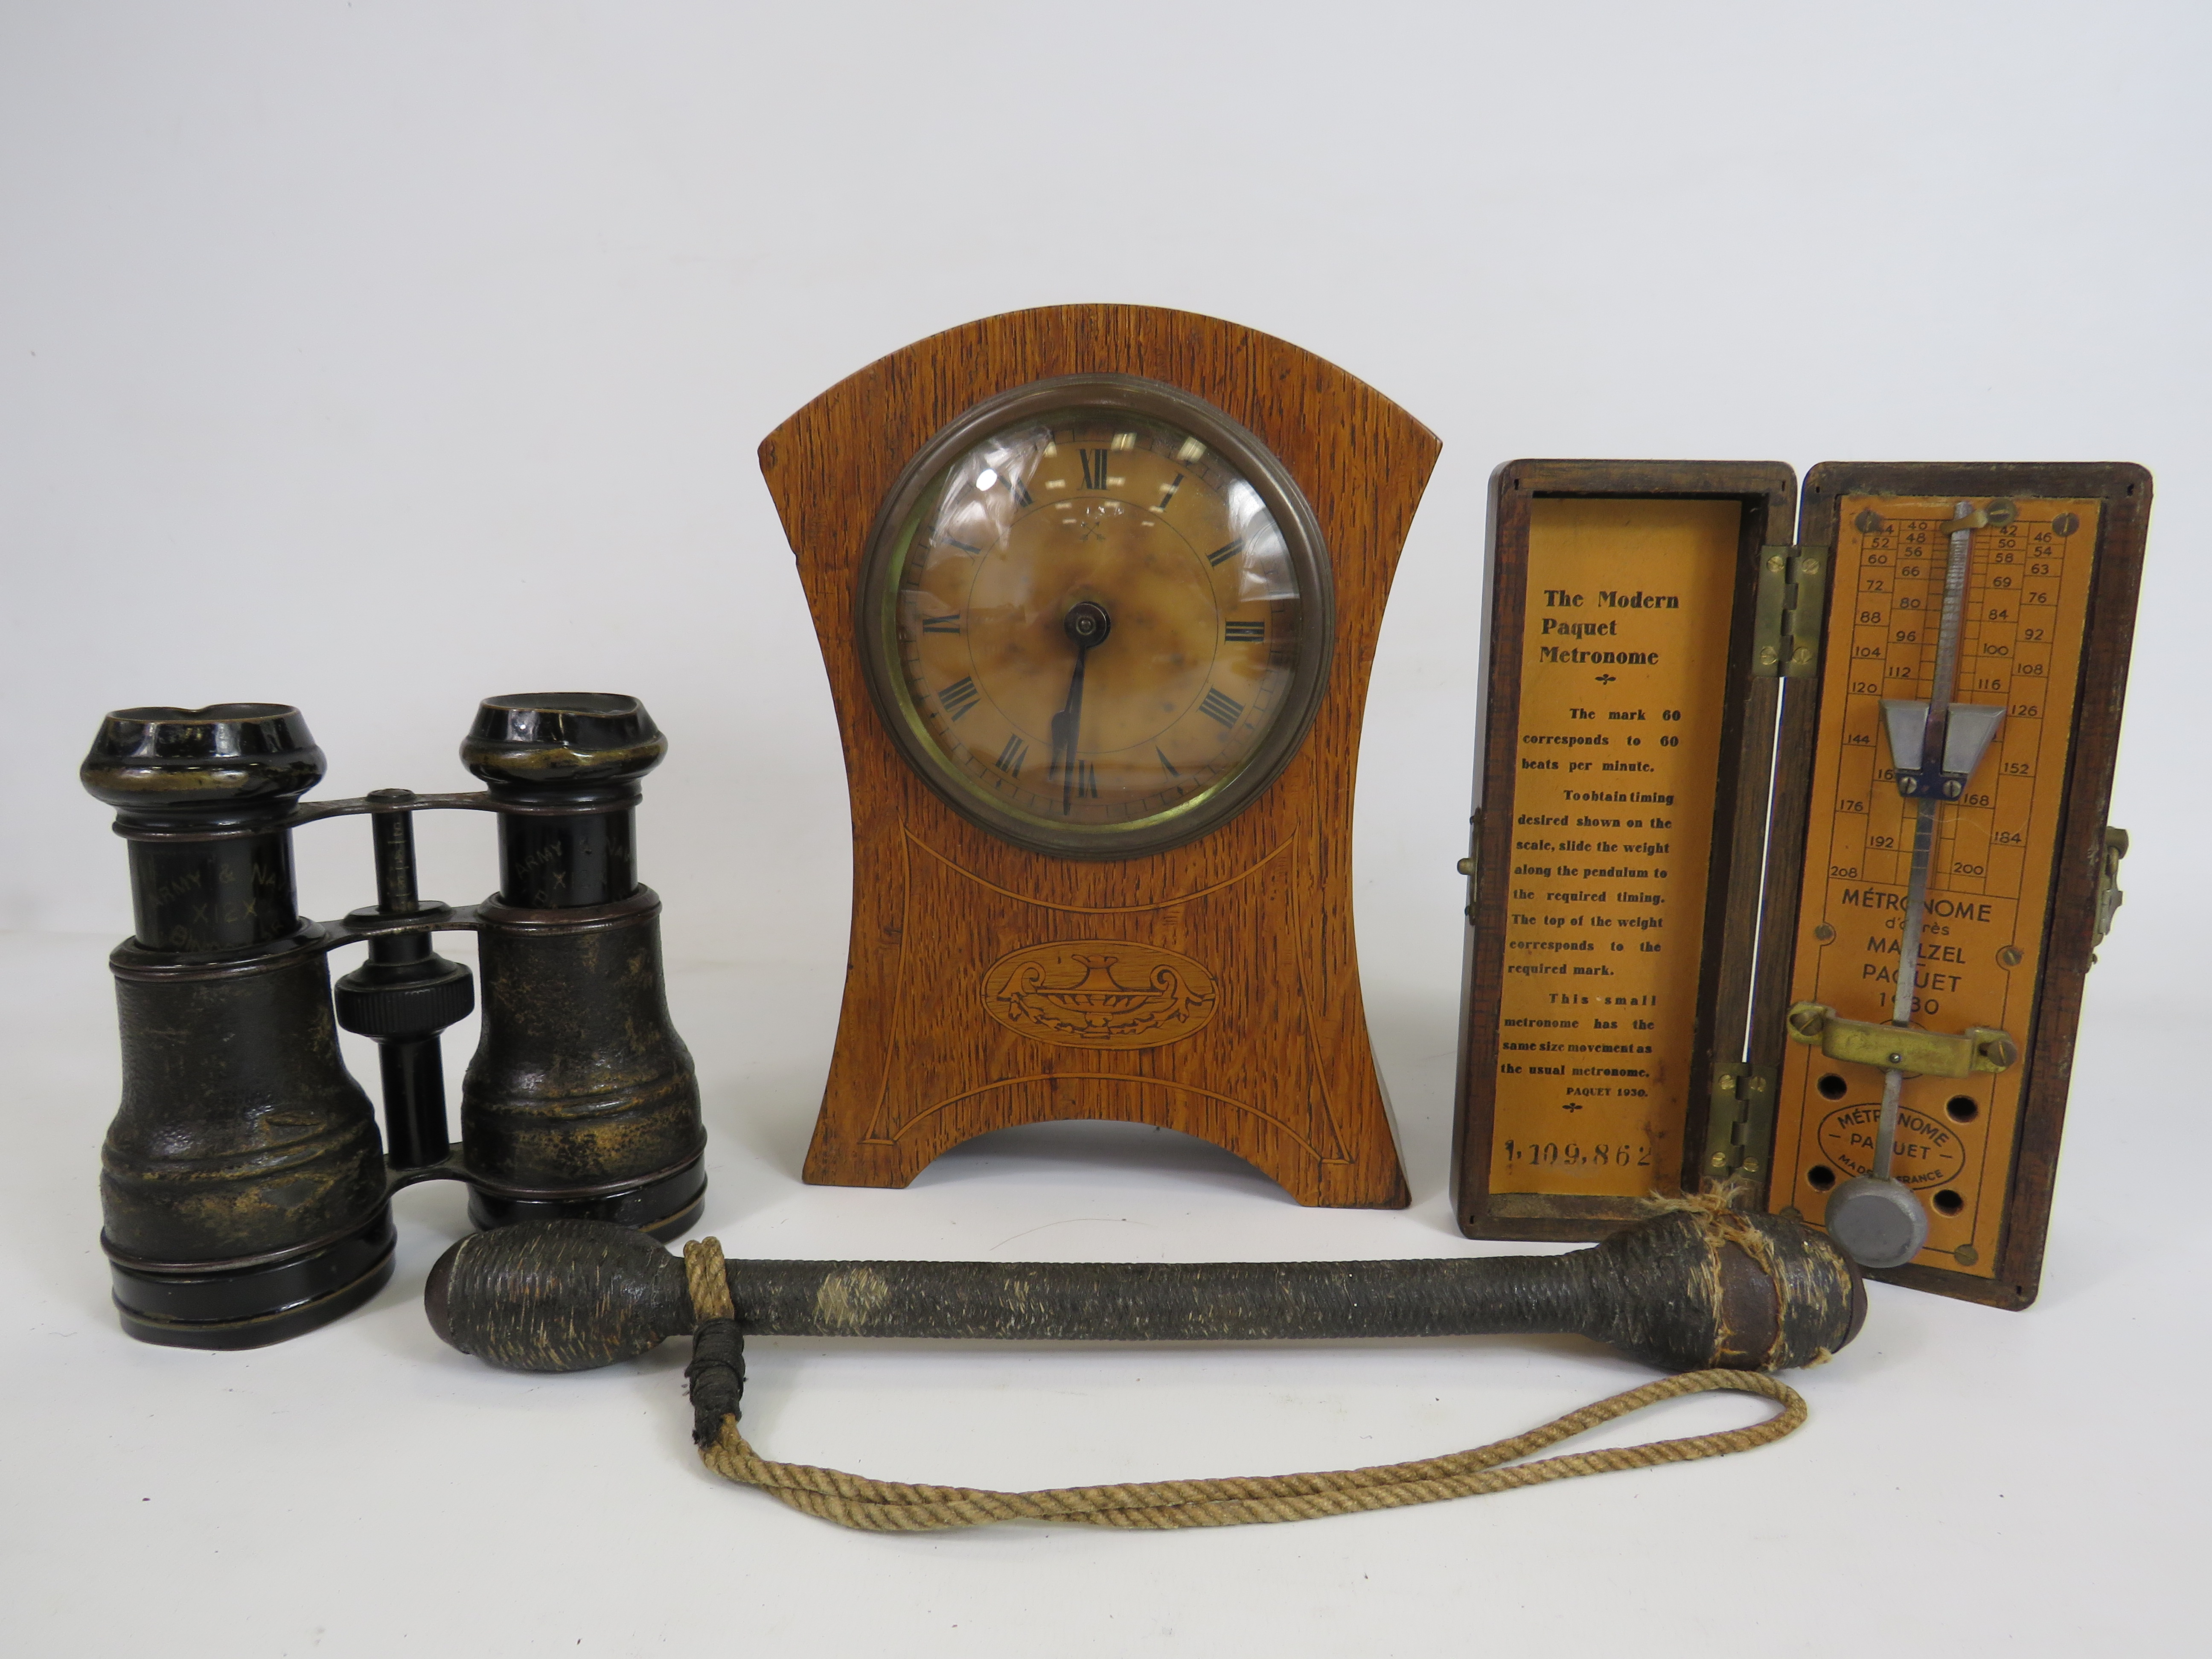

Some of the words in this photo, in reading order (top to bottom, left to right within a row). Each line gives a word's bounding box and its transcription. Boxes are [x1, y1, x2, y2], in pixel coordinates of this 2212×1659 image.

[1075, 449, 1109, 491] XII
[1908, 520, 1930, 530] 40
[1999, 525, 2017, 536] 42
[1871, 537, 1889, 548] 52
[1906, 533, 1926, 544] 48
[1998, 538, 2016, 548] 50
[2034, 532, 2052, 543] 46
[1205, 538, 1244, 570] II
[1904, 547, 1922, 557] 56
[2034, 546, 2052, 557] 54
[1868, 554, 1887, 565] 60
[1995, 553, 2014, 564] 58
[1902, 566, 1920, 577] 66
[2031, 563, 2049, 575] 63
[1866, 580, 1883, 592] 72
[1993, 576, 2011, 588] 69
[1544, 590, 1583, 607] The
[1598, 591, 1679, 608] Modern
[1899, 597, 1921, 609] 80
[2029, 592, 2047, 604] 76
[1860, 611, 1881, 624] 88
[1988, 609, 2008, 620] 84
[1224, 618, 1265, 645] III
[1541, 618, 1617, 640] Paquet
[2025, 629, 2044, 641] 92
[1896, 631, 1916, 642] 96
[1540, 646, 1659, 665] Metronome
[1856, 646, 1881, 658] 104
[1983, 643, 2009, 656] 100
[1889, 667, 1911, 678] 112
[2017, 663, 2043, 675] 108
[1852, 682, 1877, 693] 120
[1979, 679, 2001, 690] 116
[937, 674, 981, 722] VIII
[1569, 708, 1595, 719] The
[1608, 709, 1646, 720] mark
[1662, 710, 1681, 721] 60
[2011, 704, 2037, 716] 126
[1522, 734, 1609, 748] corresponds
[1627, 736, 1641, 746] to
[1660, 736, 1679, 747] 60
[1848, 734, 1870, 744] 144
[993, 731, 1029, 781] VII
[1155, 744, 1181, 783] V
[1522, 758, 1559, 769] beats
[1569, 762, 1592, 773] per
[1602, 760, 1654, 772] minute.
[2004, 763, 2029, 774] 152
[1877, 769, 1895, 780] 16
[1630, 792, 1675, 806] timing
[1964, 794, 1989, 807] 168
[1840, 800, 1863, 812] 176
[1517, 814, 1569, 826] desired
[1576, 816, 1620, 827] shown
[1627, 820, 1642, 828] on
[1650, 818, 1672, 829] the
[1870, 836, 1894, 848] 192
[1994, 832, 2022, 844] 184
[1516, 839, 1555, 852] scale,
[1559, 840, 1591, 852] slide
[1597, 841, 1618, 852] the
[1623, 842, 1670, 856] weight
[514, 840, 563, 880] ARMY
[1514, 864, 1551, 878] along
[1557, 865, 1578, 876] the
[1583, 867, 1648, 879] pendulum
[1654, 868, 1668, 878] to
[1831, 866, 1858, 878] 208
[1953, 862, 1984, 875] 200
[1513, 889, 1534, 899] the
[1547, 891, 1606, 904] required
[1617, 891, 1665, 906] timing.
[1511, 914, 1536, 925] The
[1544, 915, 1565, 928] top
[1570, 915, 1583, 926] of
[1591, 916, 1612, 927] the
[1618, 917, 1663, 931] weight
[1509, 940, 1594, 952] corresponds
[1610, 942, 1624, 952] to
[1640, 941, 1661, 952] the
[1867, 936, 1966, 964] MALZEL
[1508, 963, 1567, 976] required
[1573, 965, 1614, 975] mark.
[1549, 993, 1589, 1004] This
[1604, 995, 1656, 1006] small
[1504, 1018, 1578, 1028] metronome
[1594, 1019, 1618, 1029] has
[1633, 1019, 1654, 1030] the
[1502, 1042, 1537, 1051] same
[1539, 1041, 1564, 1051] size
[1568, 1044, 1634, 1053] movement
[1636, 1045, 1653, 1054] as
[1501, 1063, 1522, 1074] the
[1529, 1065, 1565, 1075] usual
[1572, 1067, 1650, 1078] metronome.
[1566, 1087, 1611, 1097] PAQUET
[1618, 1088, 1648, 1097] 1930.
[1837, 1109, 1950, 1147] MÉTRNOME
[1850, 1133, 1931, 1160] PAUET
